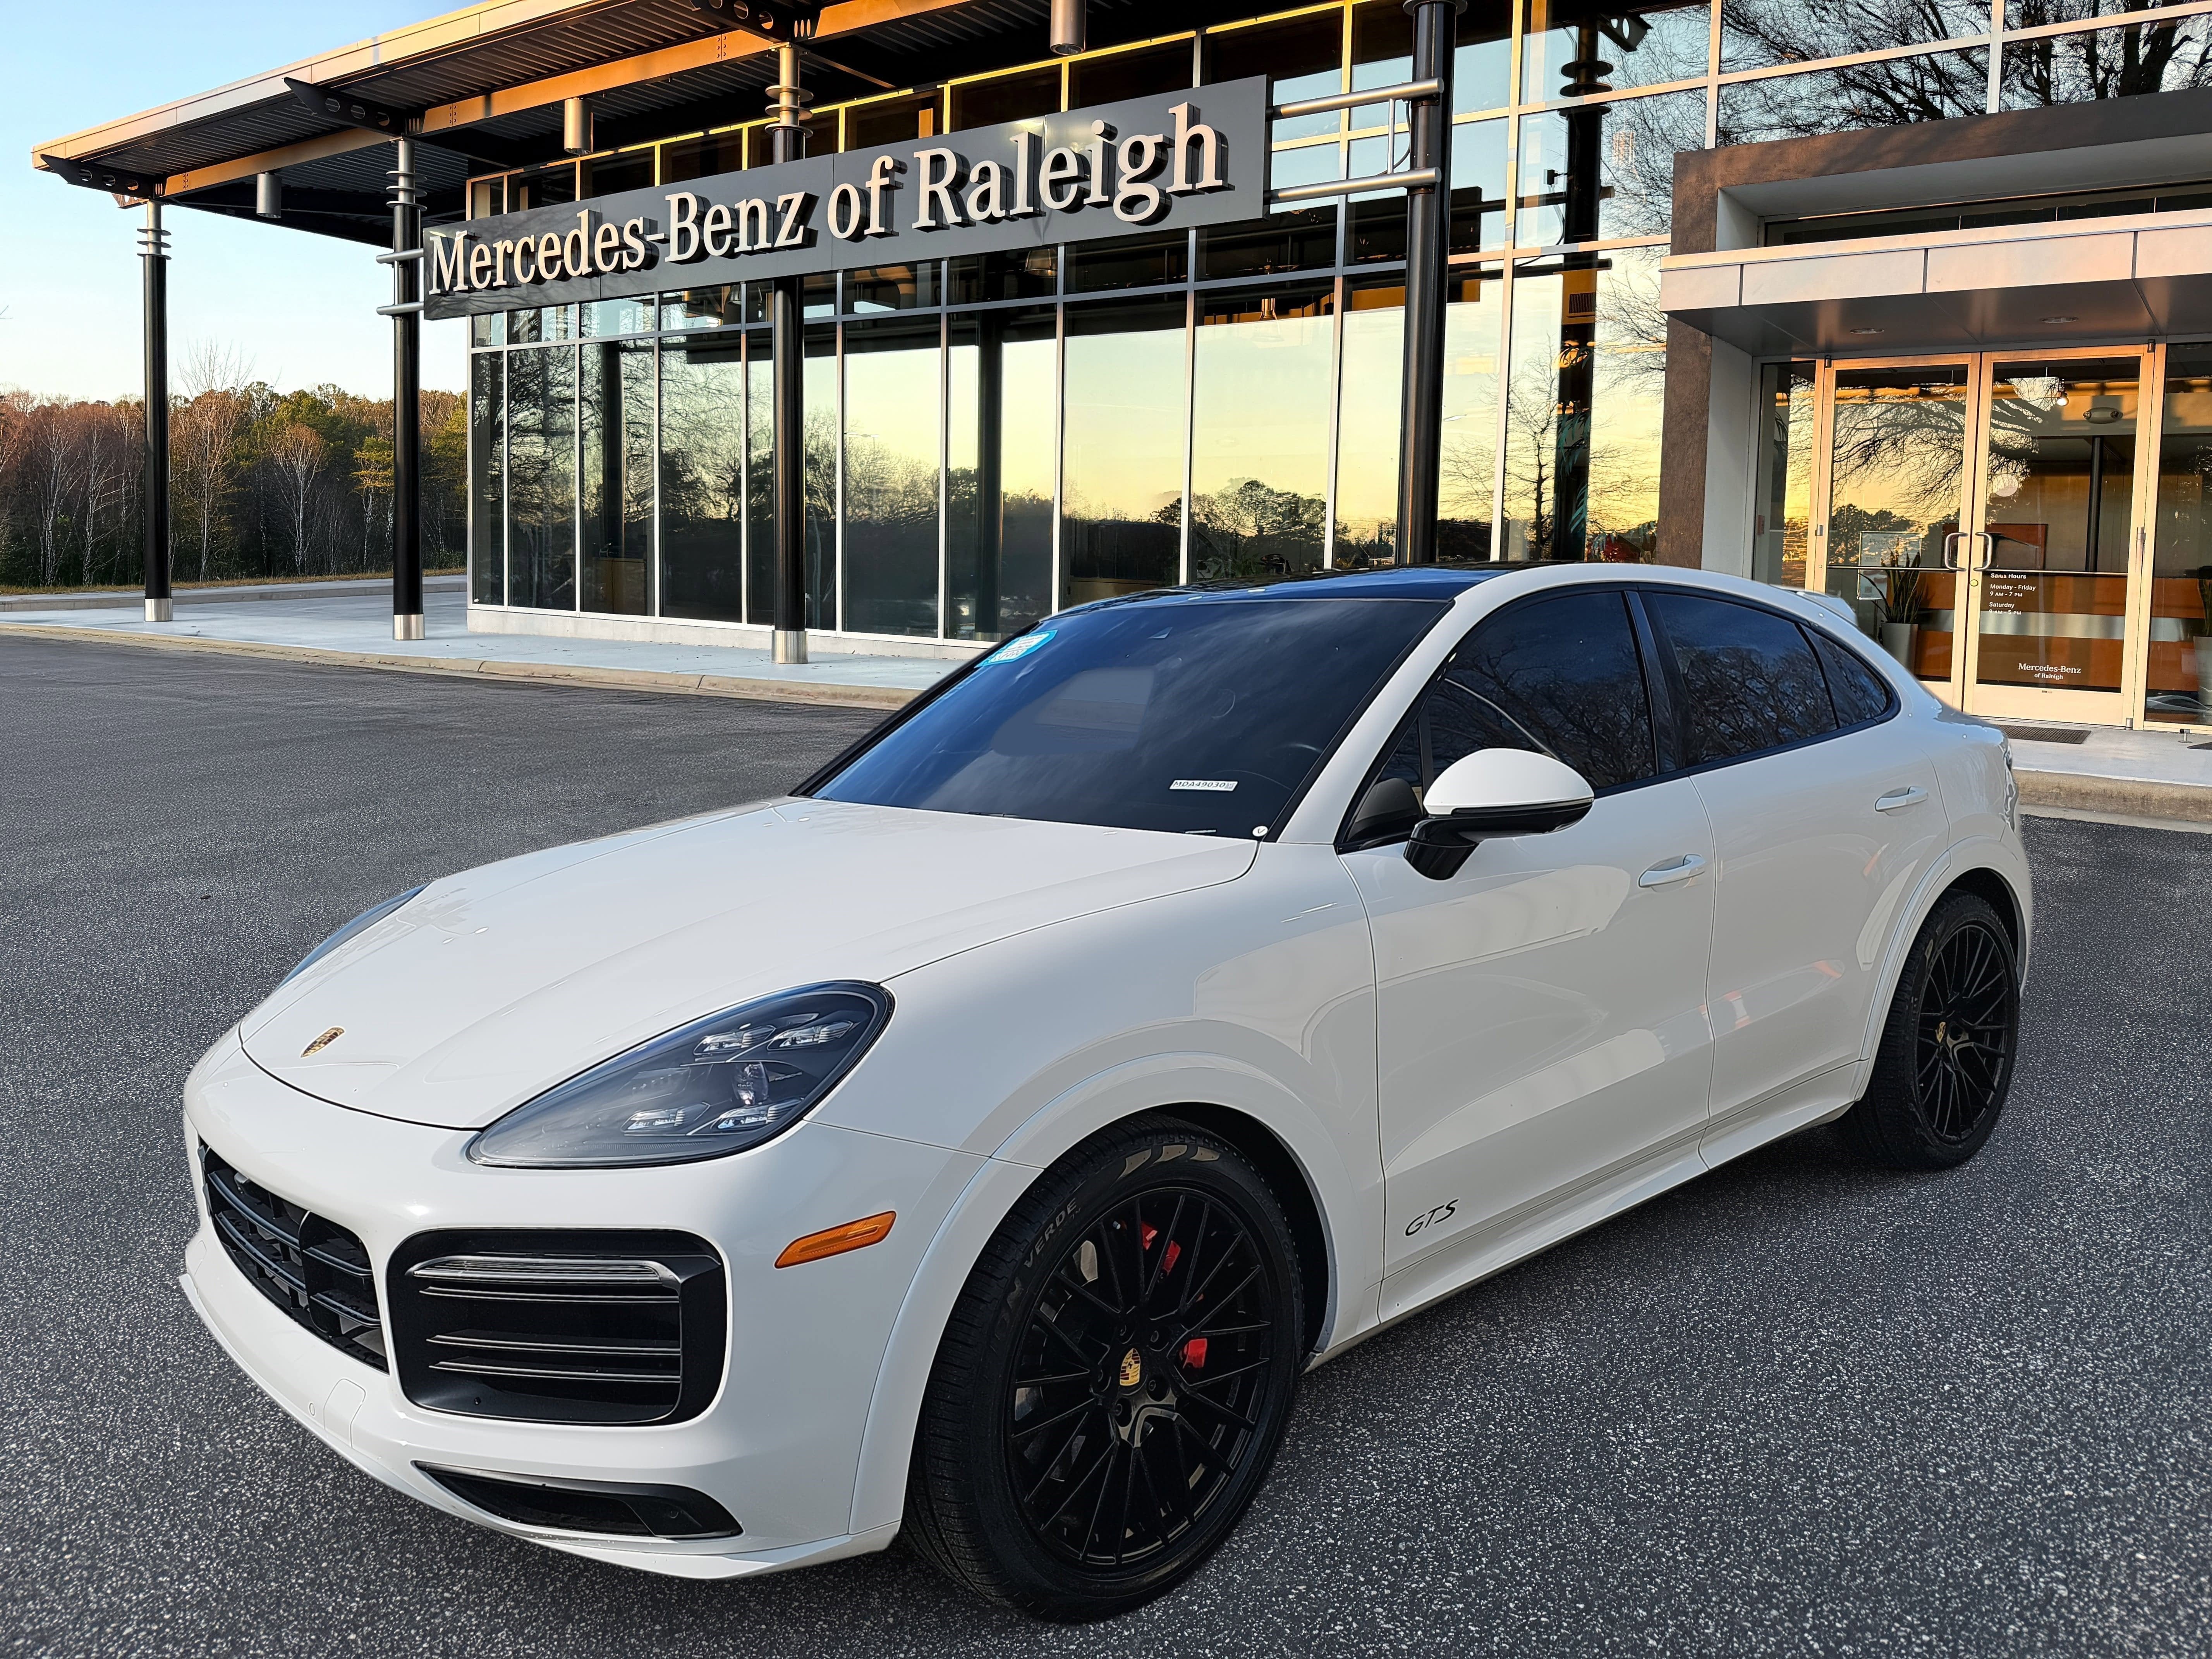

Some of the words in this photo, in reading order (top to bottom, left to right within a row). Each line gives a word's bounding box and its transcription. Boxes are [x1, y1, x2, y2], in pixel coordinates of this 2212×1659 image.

[429, 191, 806, 296] Mercedes-Benz
[827, 155, 894, 239] of
[912, 101, 1224, 222] Raleigh
[2018, 663, 2081, 674] Mercedes-Benz
[1024, 1197, 1077, 1267] VERDE
[1405, 1198, 1459, 1236] GTS
